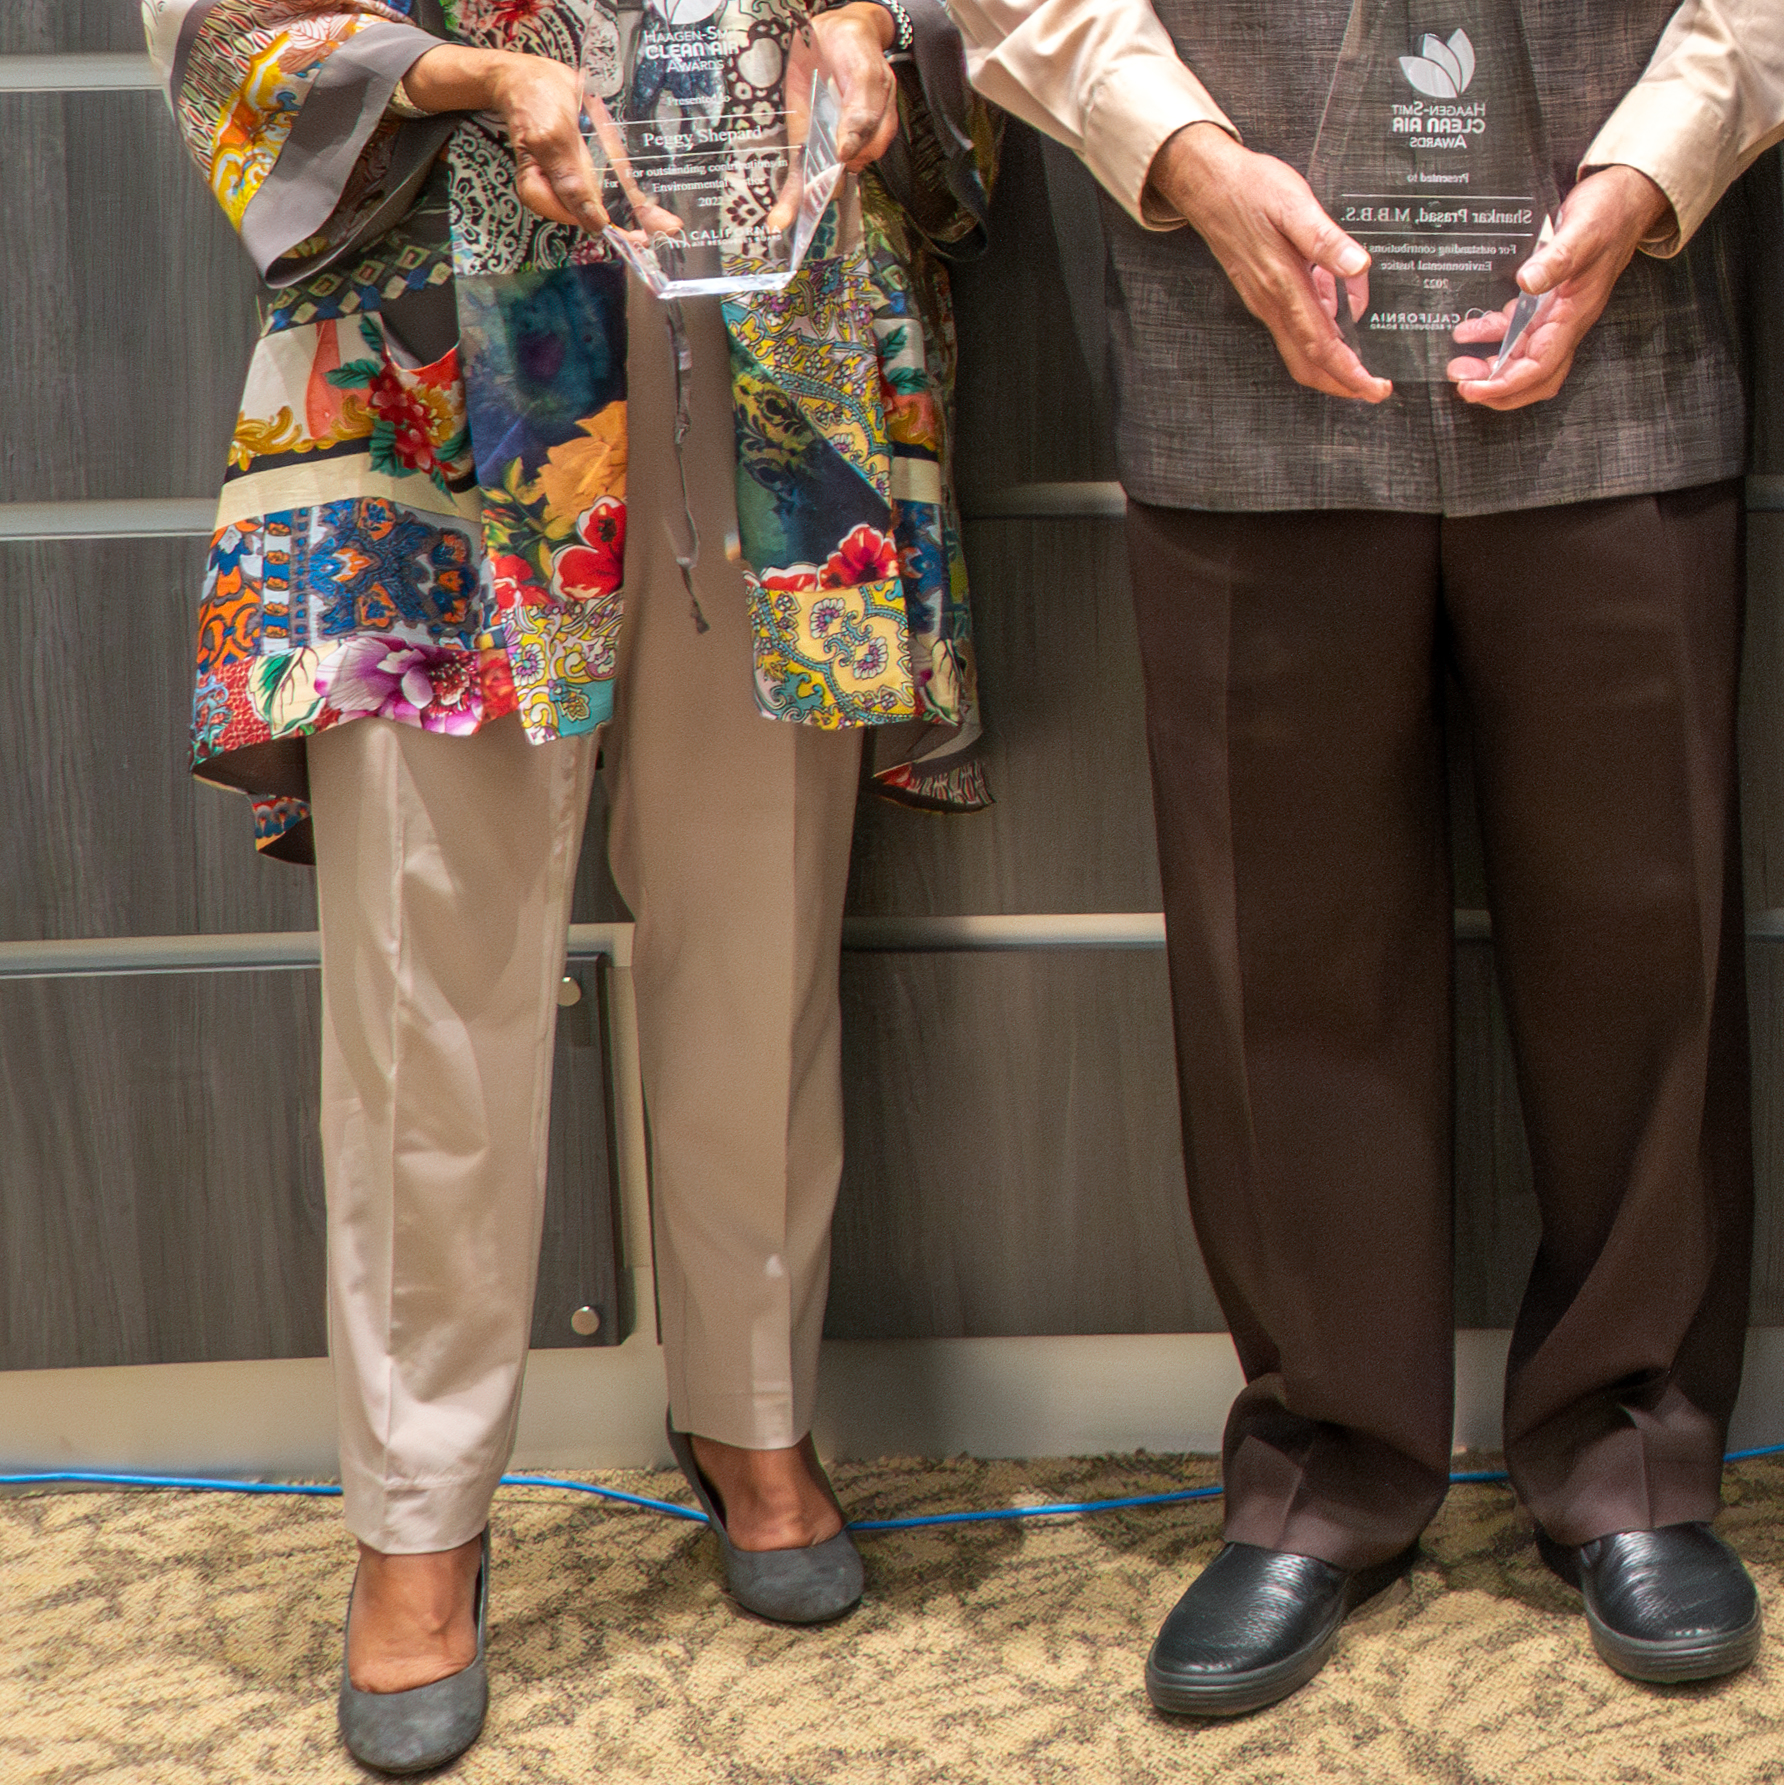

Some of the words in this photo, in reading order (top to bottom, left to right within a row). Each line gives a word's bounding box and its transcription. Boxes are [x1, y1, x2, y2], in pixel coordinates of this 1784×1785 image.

[711, 40, 739, 57] AIR
[643, 132, 693, 151] Peggy
[698, 125, 762, 144] Shepard
[652, 179, 729, 193] Environmental
[697, 196, 724, 207] 2022
[690, 225, 782, 240] CALIFORNIA
